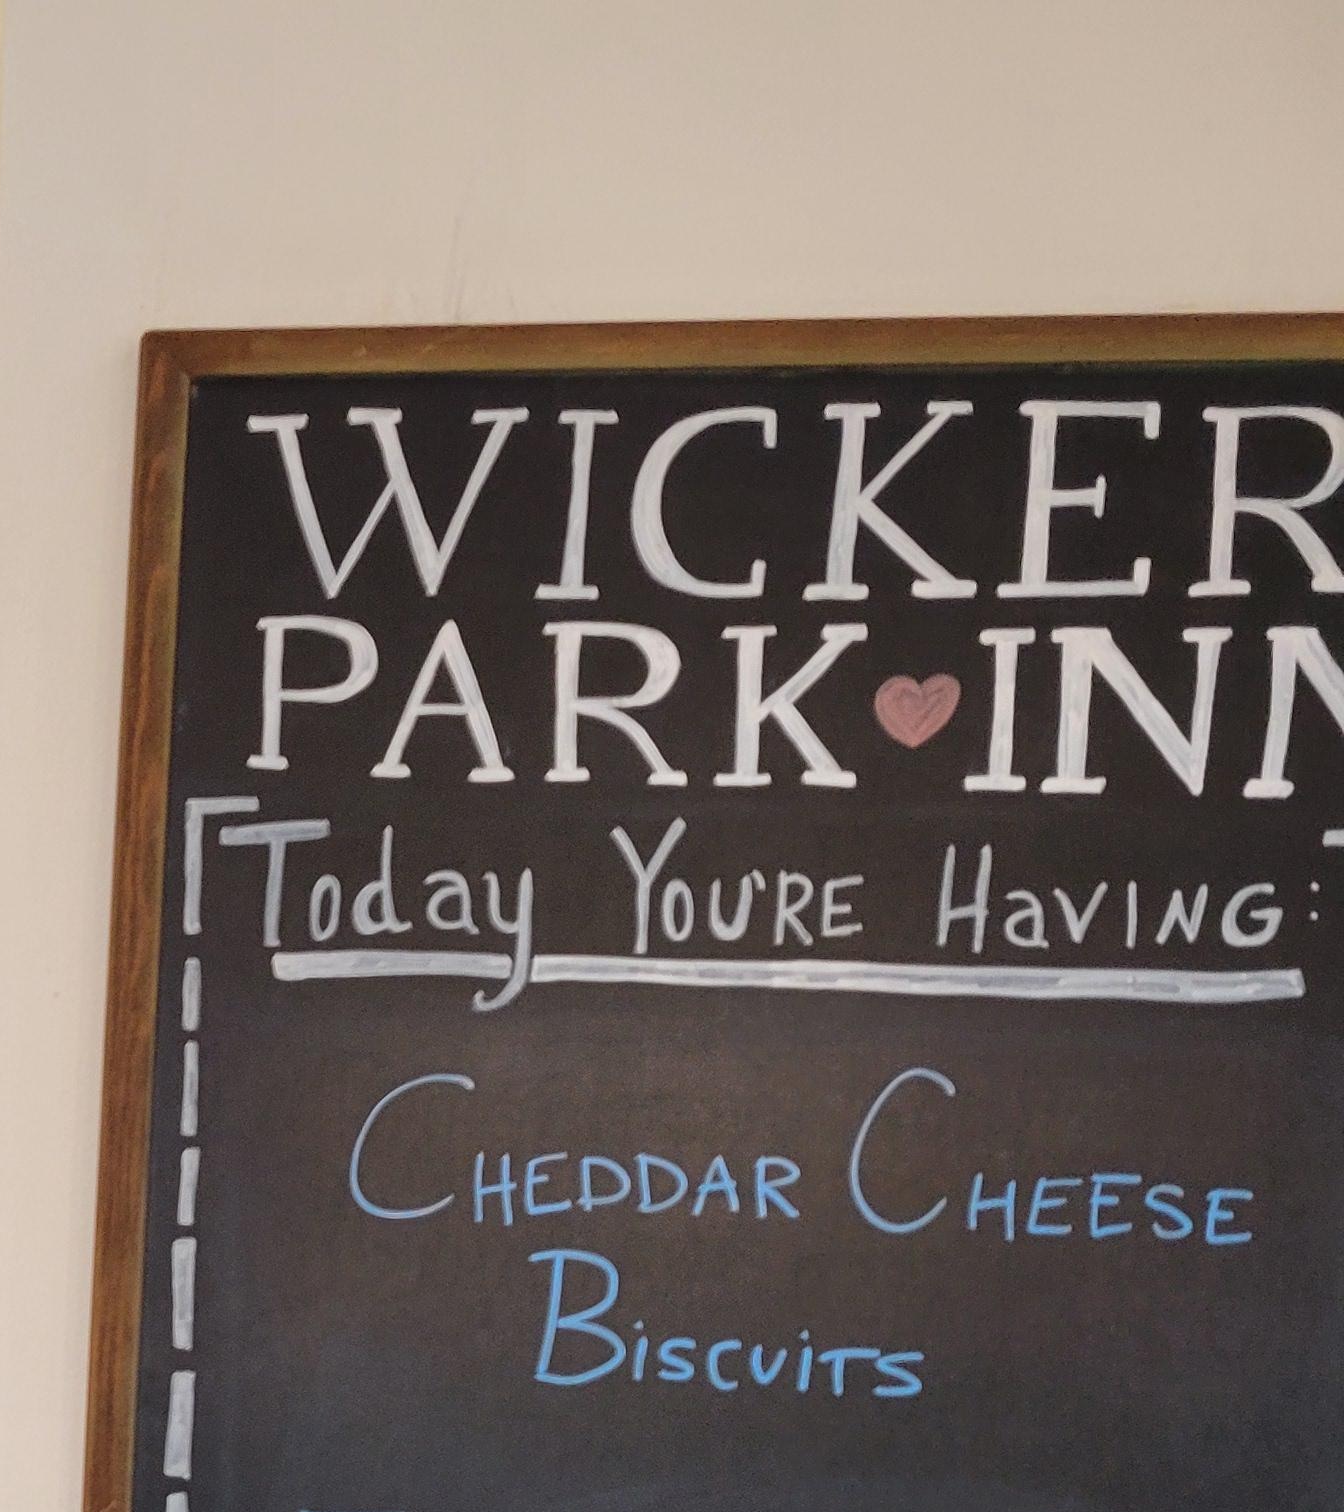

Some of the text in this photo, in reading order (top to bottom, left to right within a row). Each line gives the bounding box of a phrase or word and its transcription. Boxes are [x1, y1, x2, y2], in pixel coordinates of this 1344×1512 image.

[247, 399, 1344, 600] WICKER
[246, 615, 869, 788] PARK
[219, 818, 534, 1011] Today
[349, 1067, 1254, 1243] CHEDDAR CHEESE
